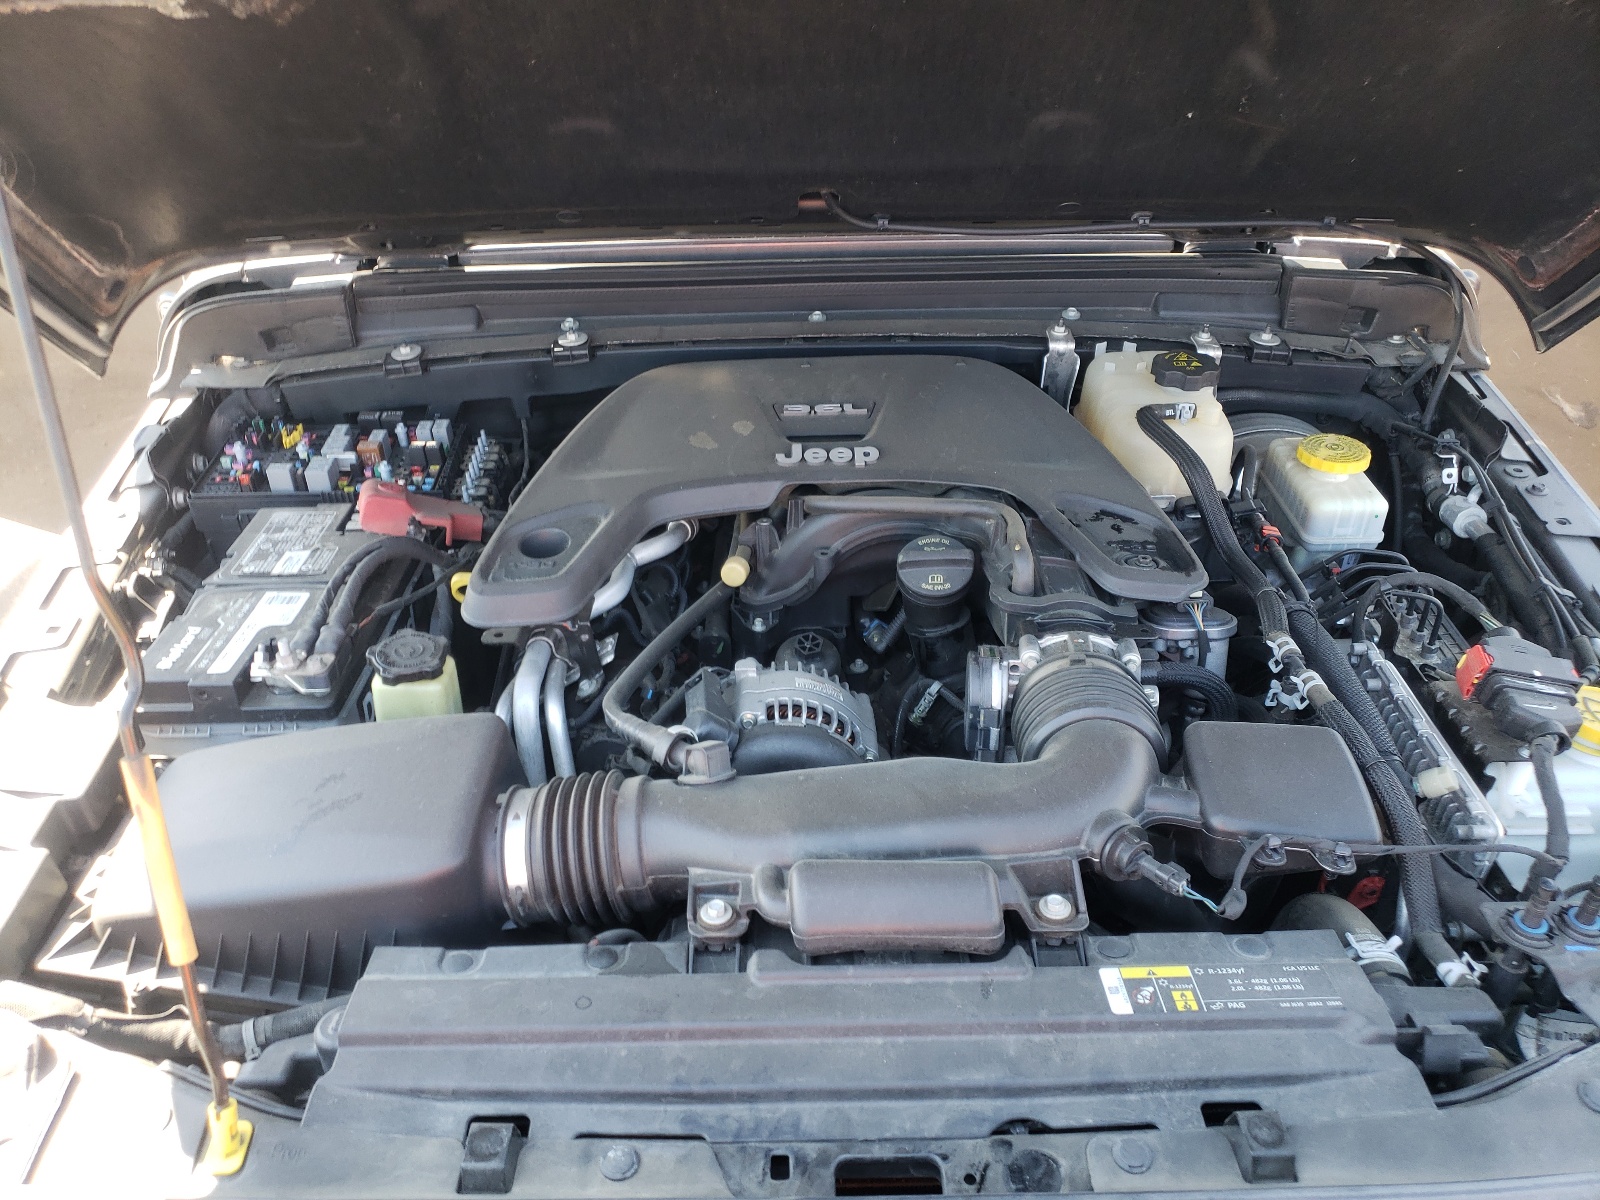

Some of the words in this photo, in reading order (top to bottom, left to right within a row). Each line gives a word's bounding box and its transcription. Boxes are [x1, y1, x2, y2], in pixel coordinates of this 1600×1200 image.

[775, 443, 880, 468] Jeep
[918, 538, 940, 546] ENGINE
[1208, 967, 1245, 975] R-1234yf
[1227, 1001, 1246, 1009] PAG
